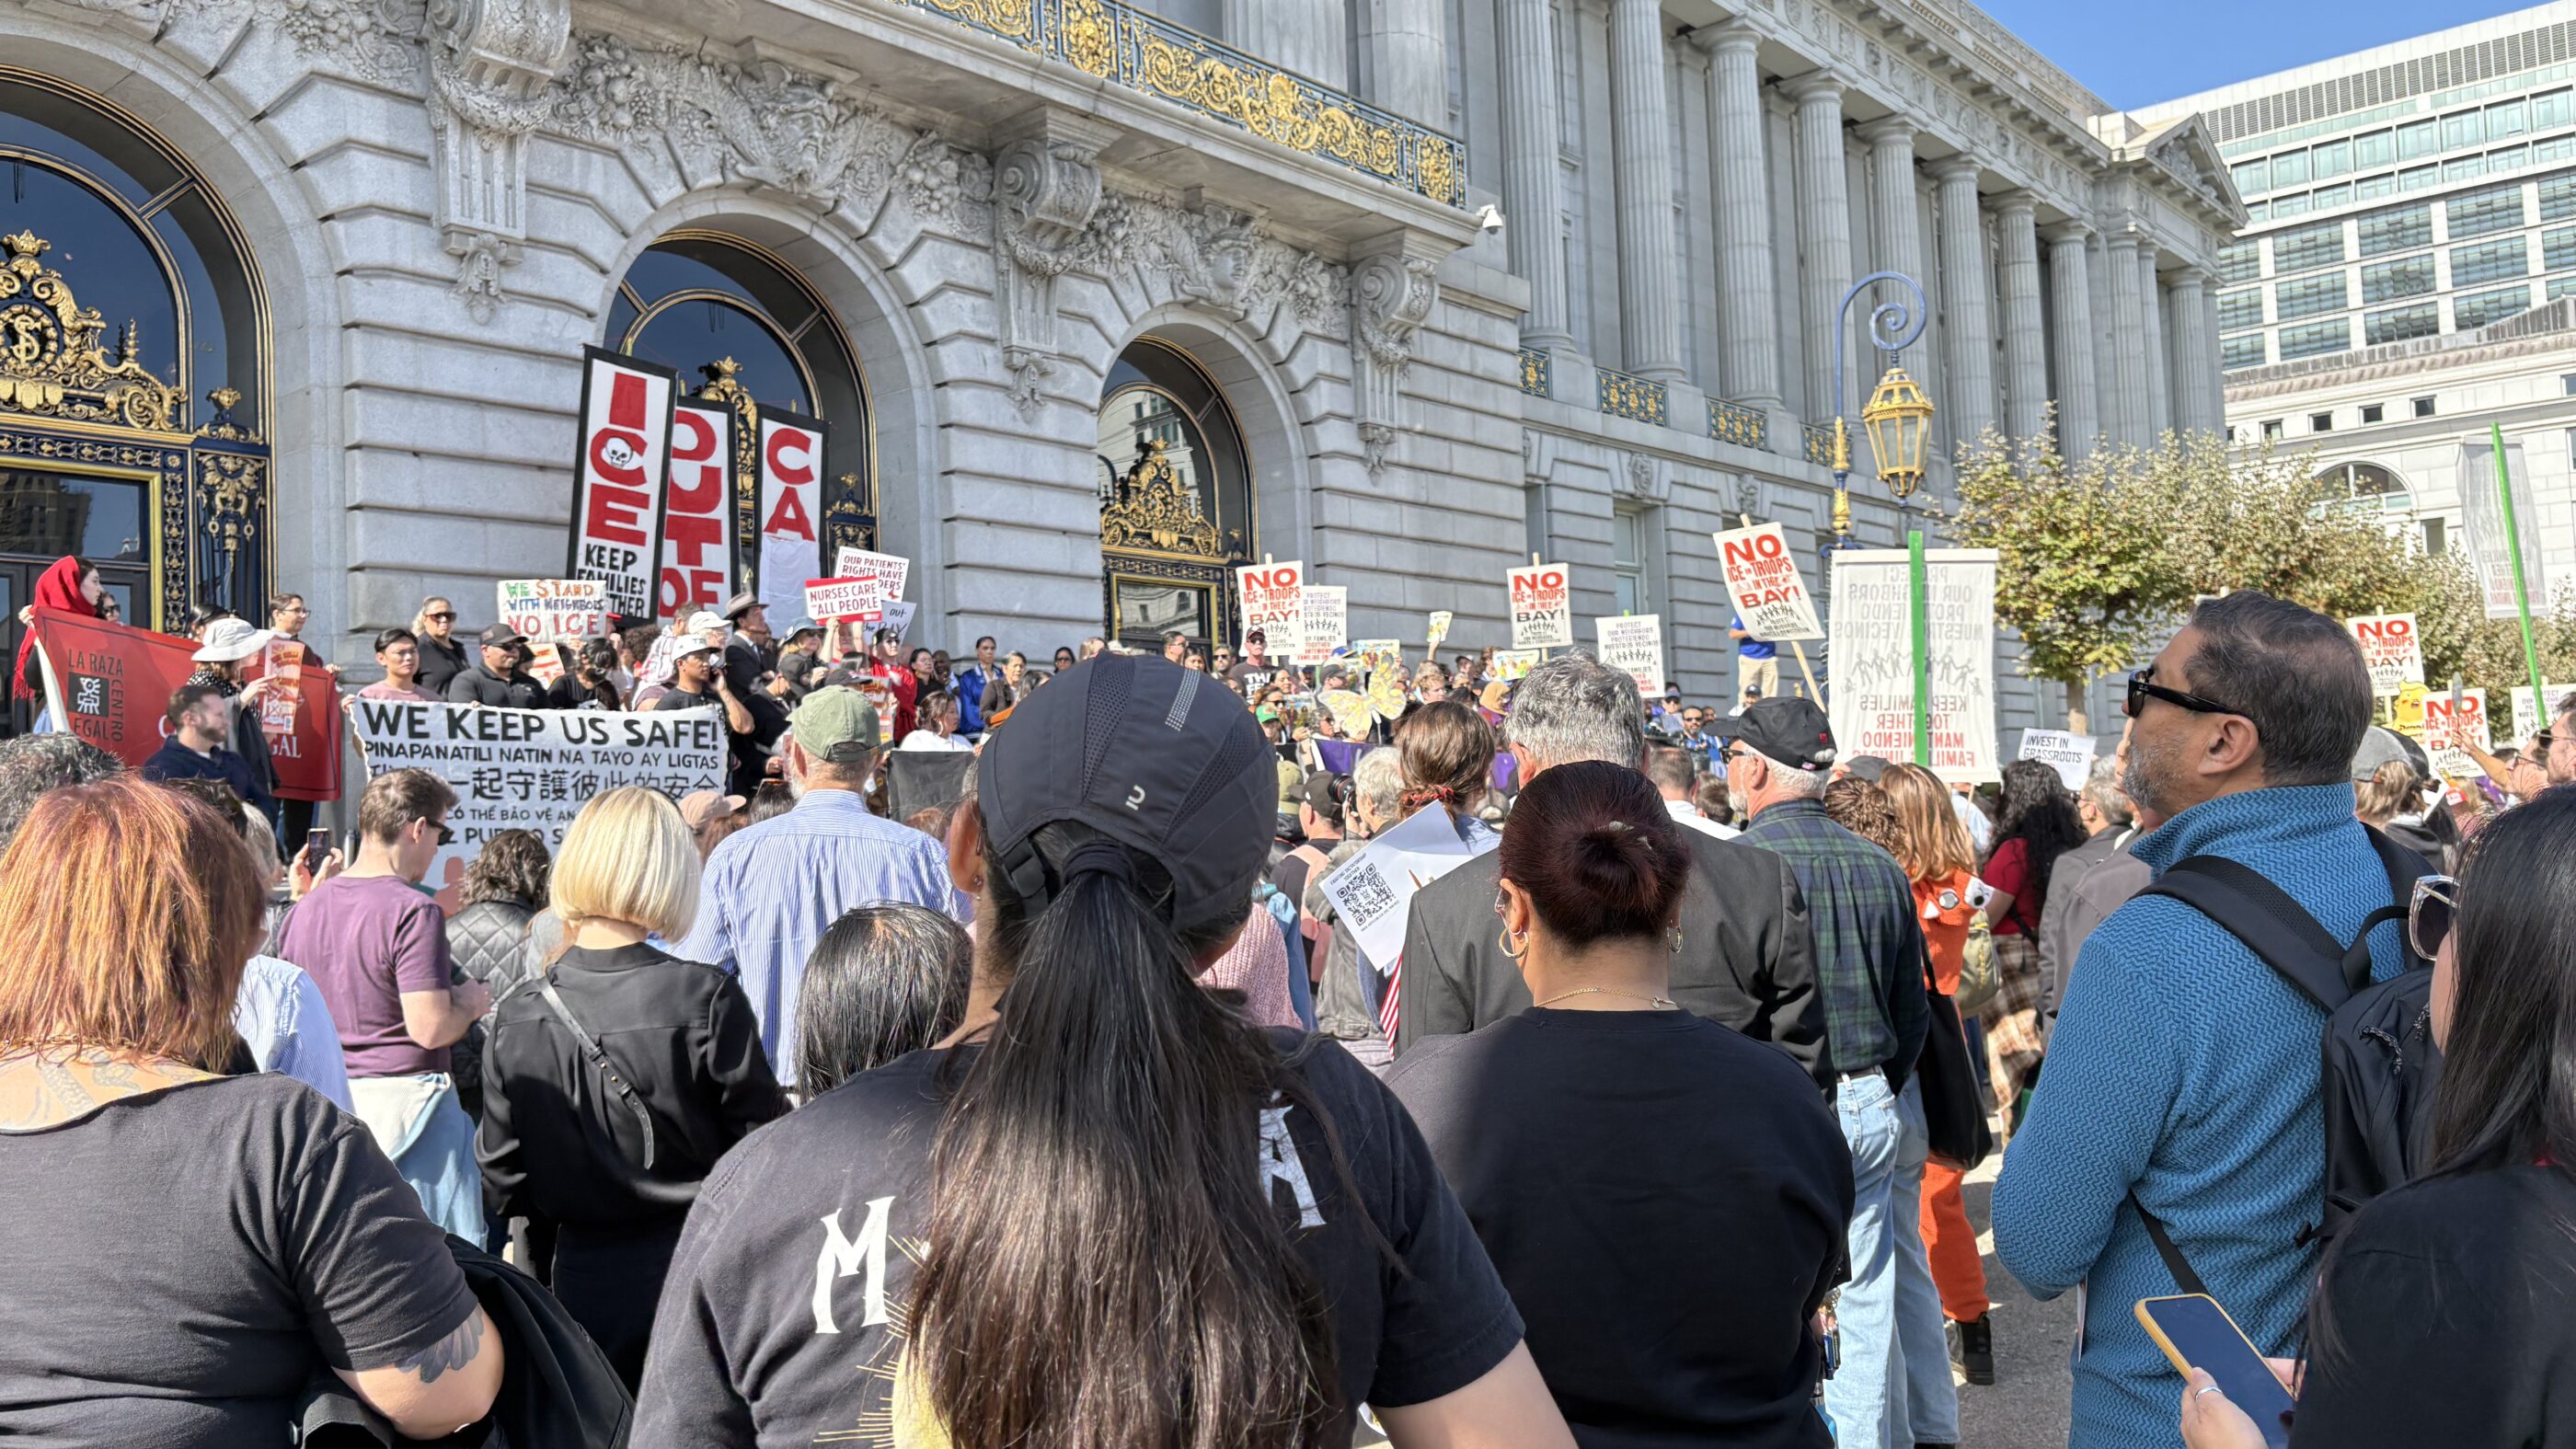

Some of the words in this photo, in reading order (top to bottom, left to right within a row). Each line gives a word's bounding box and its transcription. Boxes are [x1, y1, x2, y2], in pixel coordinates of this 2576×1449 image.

[586, 372, 650, 546] ICE
[584, 543, 638, 572] KEEP
[1724, 535, 1782, 565] NO
[842, 564, 876, 576] RIGHTS
[879, 569, 903, 581] HAVE
[844, 556, 863, 565] OUR
[864, 558, 905, 570] PATIENTS'
[1727, 565, 1745, 582] ICE
[1750, 557, 1793, 577] TROOPS
[506, 582, 530, 598] WE
[535, 580, 594, 598] STAND
[1244, 569, 1297, 592] NO
[1513, 572, 1563, 592] NO
[1753, 580, 1762, 590] IN
[658, 568, 725, 618] OF
[810, 587, 849, 603] NURSES
[851, 583, 877, 597] CARE
[1244, 592, 1259, 604] ICE
[1264, 586, 1301, 602] TROOPS
[1512, 592, 1526, 604] ICE
[1533, 588, 1566, 602] TROOPS
[1740, 585, 1801, 609] BAY!
[508, 598, 539, 611] WITH
[817, 603, 836, 615] ALL
[838, 597, 879, 612] PEOPLE
[508, 615, 542, 636] NO
[553, 614, 600, 636] ICE
[1249, 610, 1299, 626] BAY!
[1516, 608, 1565, 623] BAY!
[2356, 620, 2410, 638] NO
[2358, 638, 2371, 650] CE
[2377, 636, 2415, 648] TROOPS
[68, 649, 85, 669] LA
[89, 652, 123, 677] RAZA
[2366, 656, 2414, 668] BAY!
[110, 679, 124, 742] CENTRO
[2426, 696, 2479, 718] NO
[73, 717, 109, 741] EGAL
[362, 702, 431, 740] WE
[446, 707, 546, 742] KEEP
[560, 716, 610, 745] US
[623, 719, 719, 751] SAFE!
[2425, 718, 2438, 731] ICE
[2446, 714, 2484, 728] TROOPS
[2026, 736, 2058, 748] INVEST
[2059, 737, 2069, 749] IN
[365, 741, 491, 762] PINAPANATILI
[500, 747, 552, 764] NATIN
[559, 750, 584, 765] NA
[592, 751, 635, 765] TAYO
[640, 753, 661, 766] AY
[668, 753, 719, 769] LIGTAS
[2024, 747, 2083, 764] GRASSROOTS
